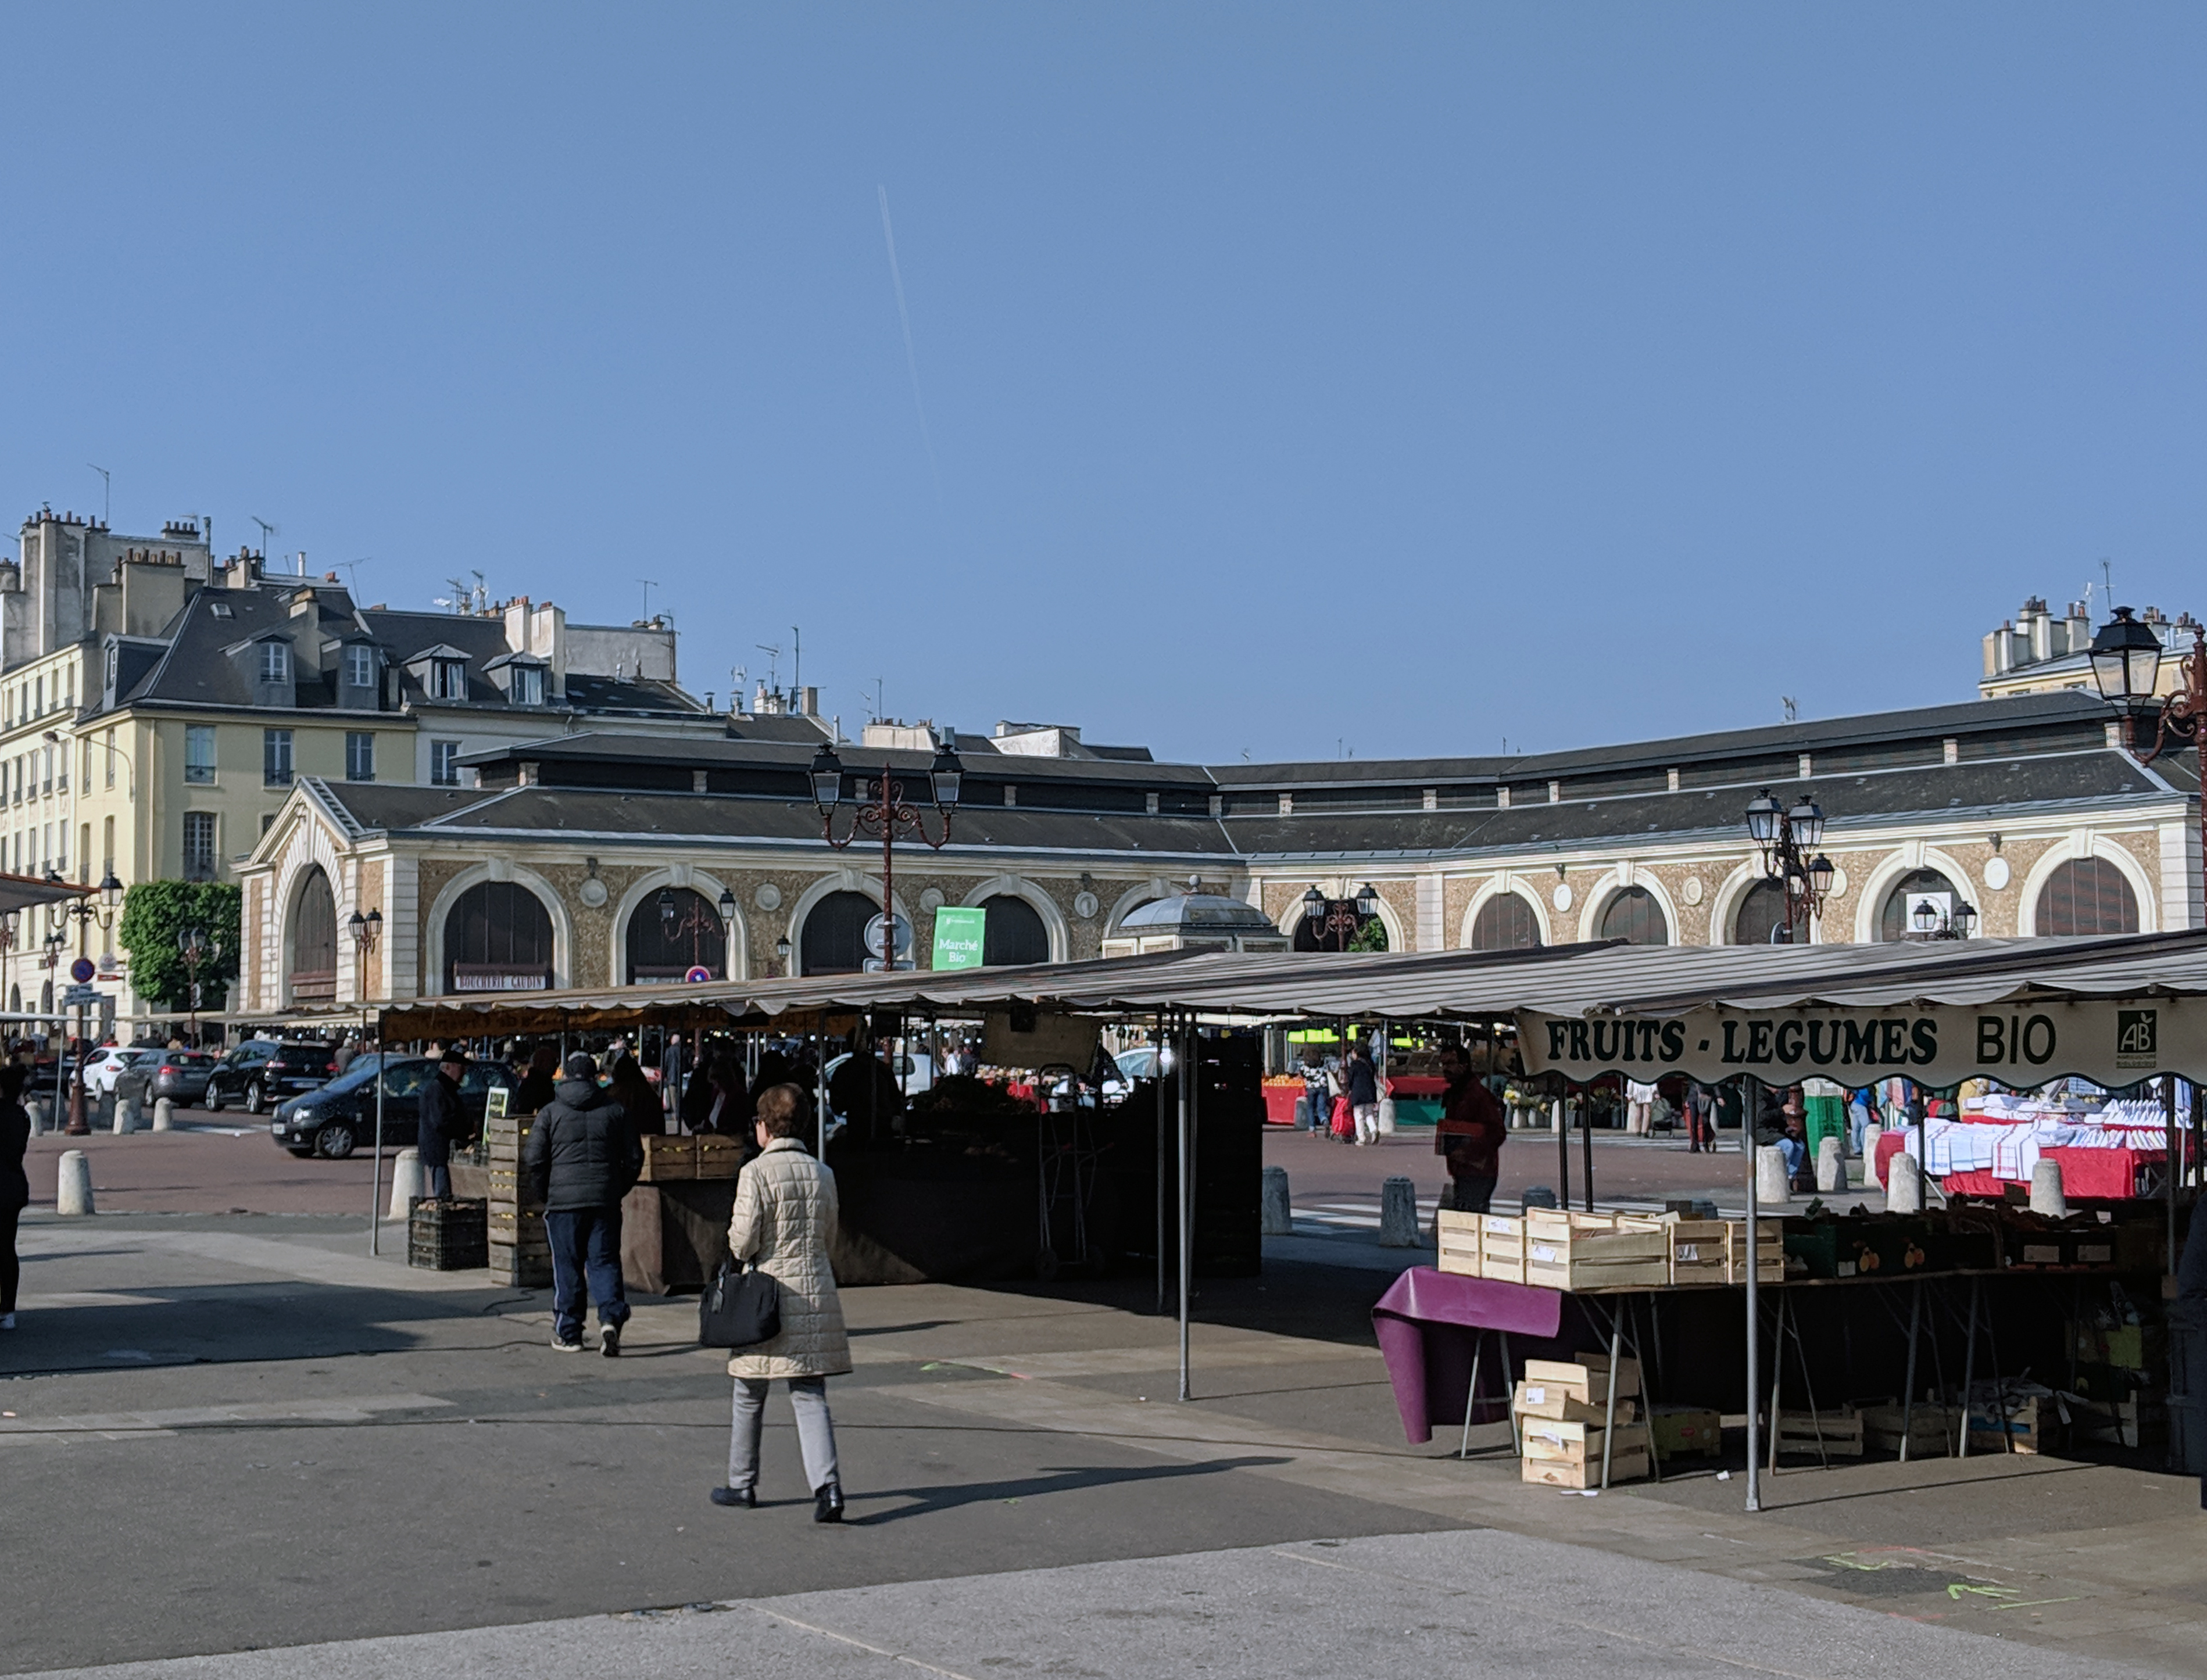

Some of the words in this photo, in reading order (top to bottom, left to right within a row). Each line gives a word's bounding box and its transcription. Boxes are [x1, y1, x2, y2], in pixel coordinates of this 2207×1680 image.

[939, 938, 978, 951] Marché
[948, 951, 966, 963] Bio
[1545, 1020, 1686, 1062] FRUITS
[1721, 1019, 1937, 1065] LEGUMES
[1977, 1015, 2056, 1065] BIO
[2120, 1022, 2151, 1051] AB
